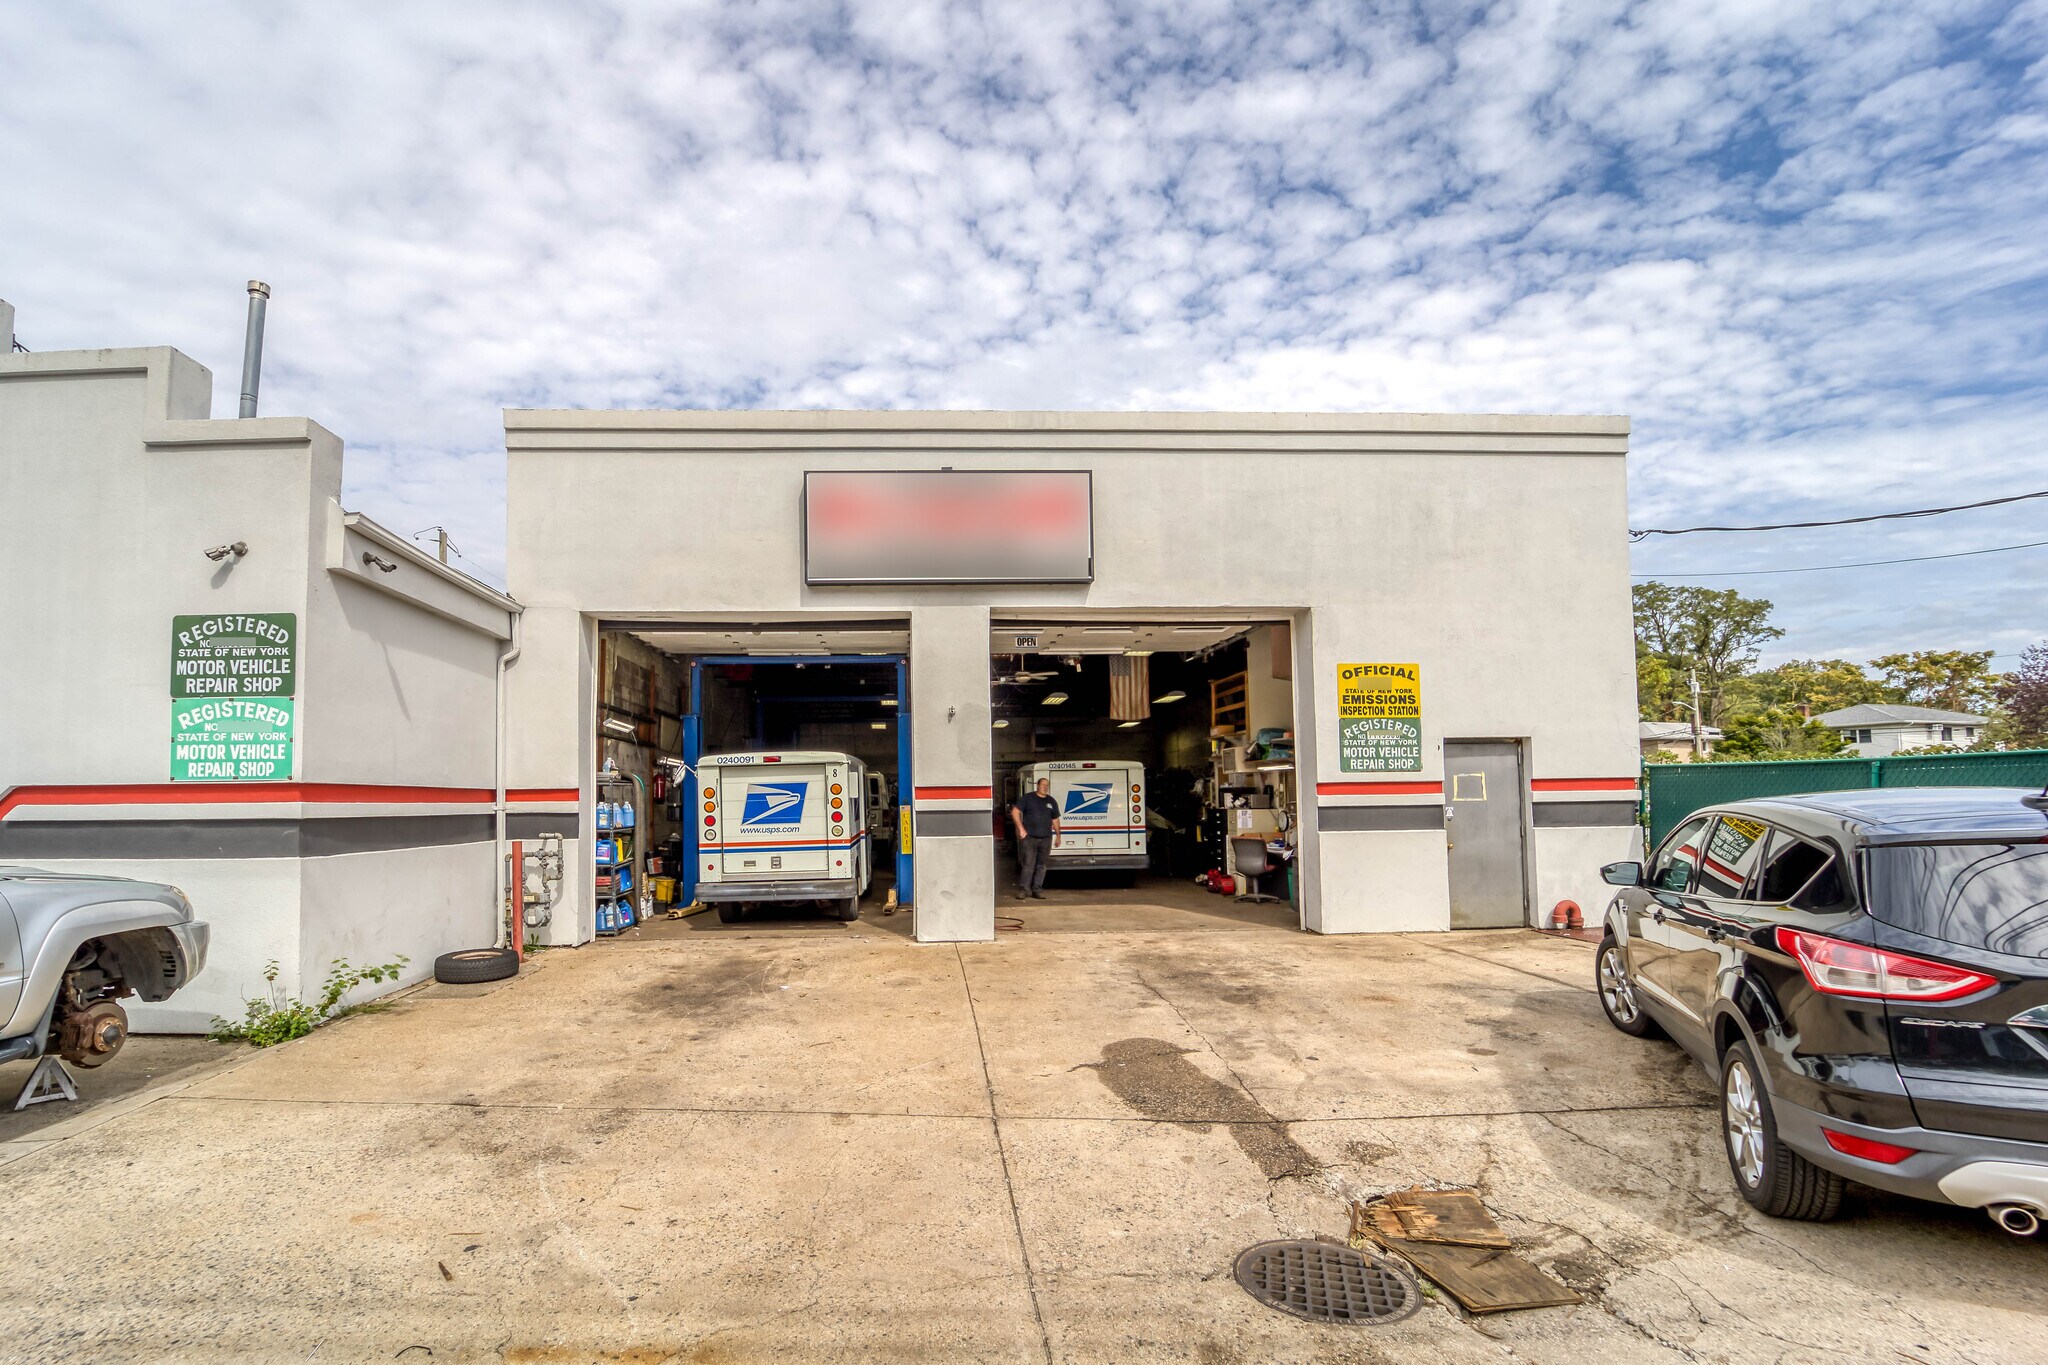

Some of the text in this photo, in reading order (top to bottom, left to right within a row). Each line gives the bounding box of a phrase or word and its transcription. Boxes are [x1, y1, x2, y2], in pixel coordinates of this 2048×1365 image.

[178, 616, 289, 647] REGISTERED
[1017, 638, 1036, 646] OPEN
[176, 659, 290, 675] MOTOR VEHICLE
[1342, 665, 1415, 681] OFFICIAL
[186, 677, 282, 693] REPAIR SHOP
[1343, 695, 1416, 704] EMISSIONS
[177, 701, 290, 730] REGISTERED
[1341, 706, 1418, 715] INSPECTION STATION
[1344, 719, 1417, 739] REGISTERED
[177, 744, 285, 760] MOTOR VEHICLE
[1344, 747, 1419, 757] MOTOR VEHICLE
[717, 756, 754, 764] 0240091
[1351, 759, 1414, 769] REPAIR SHOP
[188, 762, 274, 777] REPAIR SHOP
[832, 769, 837, 778] 8
[740, 825, 800, 834] www.usps.com
